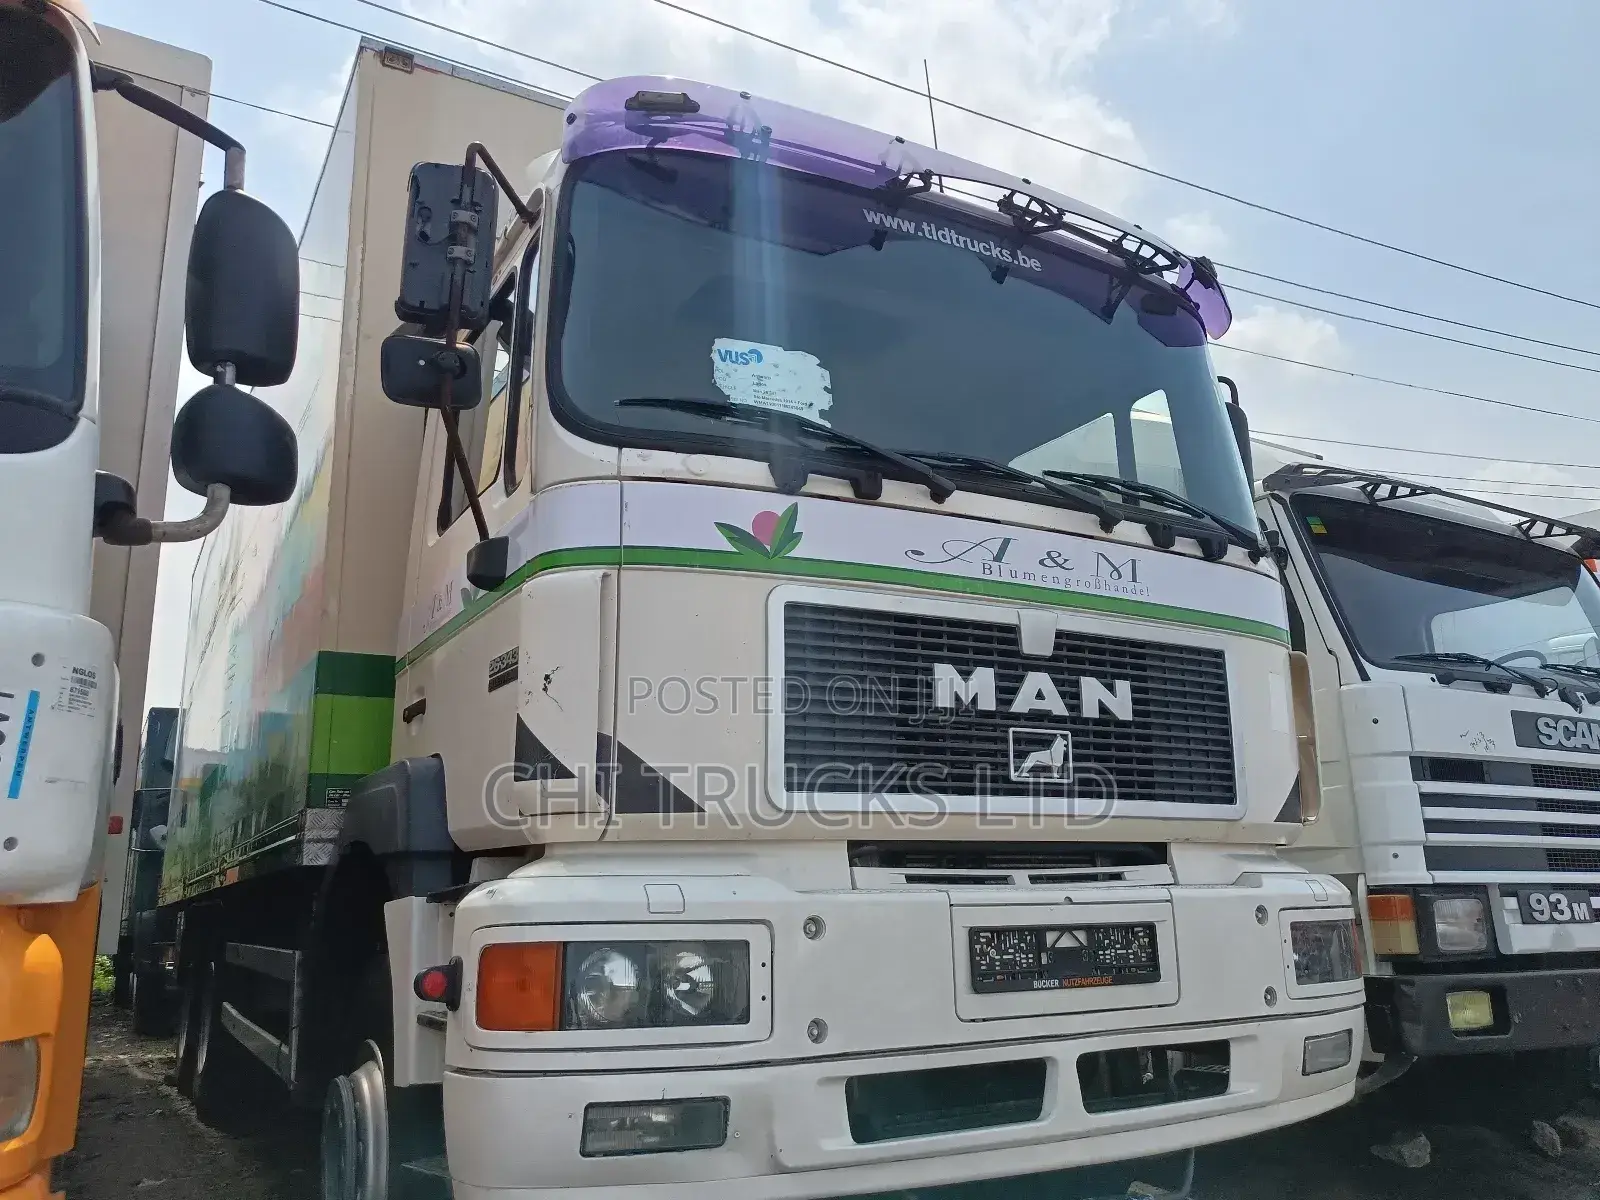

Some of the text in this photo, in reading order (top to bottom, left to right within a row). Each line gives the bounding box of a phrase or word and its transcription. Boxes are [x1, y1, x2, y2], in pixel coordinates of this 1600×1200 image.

[863, 208, 1042, 272] www.tldtrucks.be
[905, 537, 1142, 584] A & M
[981, 561, 1150, 597] Blumengroßhandel
[932, 663, 1133, 721] MAN
